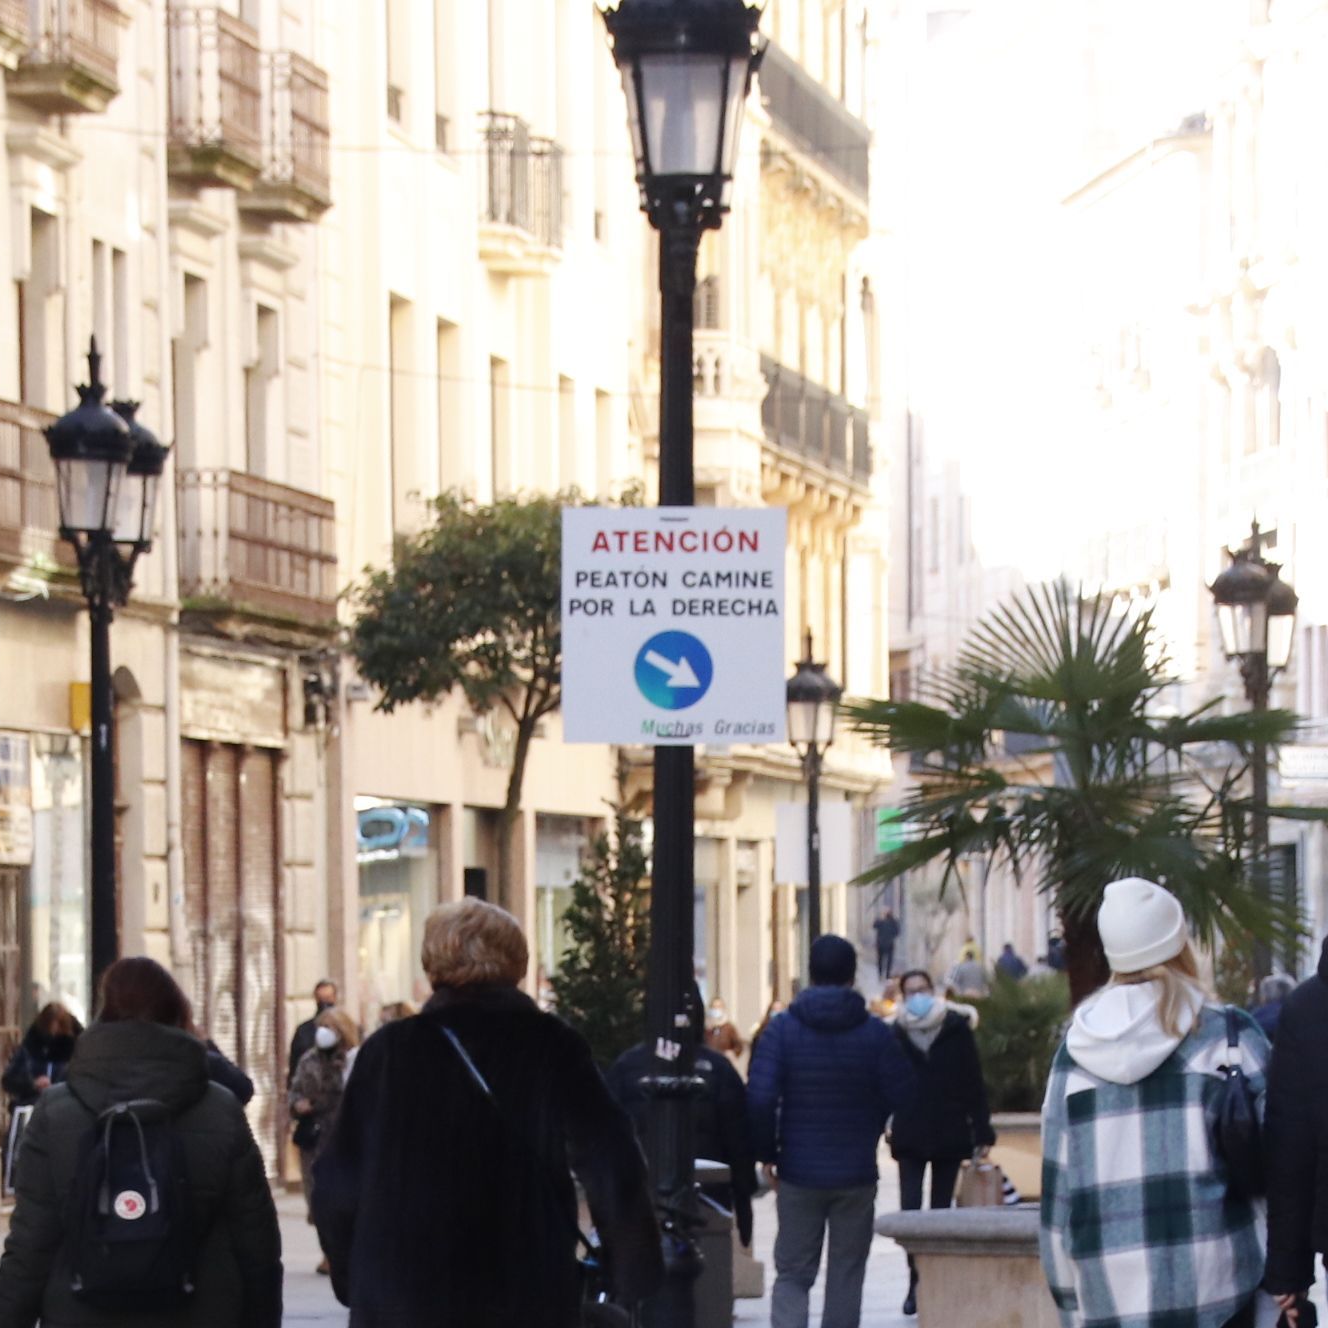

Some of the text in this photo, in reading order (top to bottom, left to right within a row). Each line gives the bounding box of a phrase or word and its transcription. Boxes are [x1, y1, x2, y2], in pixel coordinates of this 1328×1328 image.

[592, 526, 759, 552] ATENCIÓN
[575, 566, 773, 588] PEATÓN CAMINE
[569, 599, 779, 616] POR LA DERECHA
[641, 719, 776, 736] Muchas Gracias
